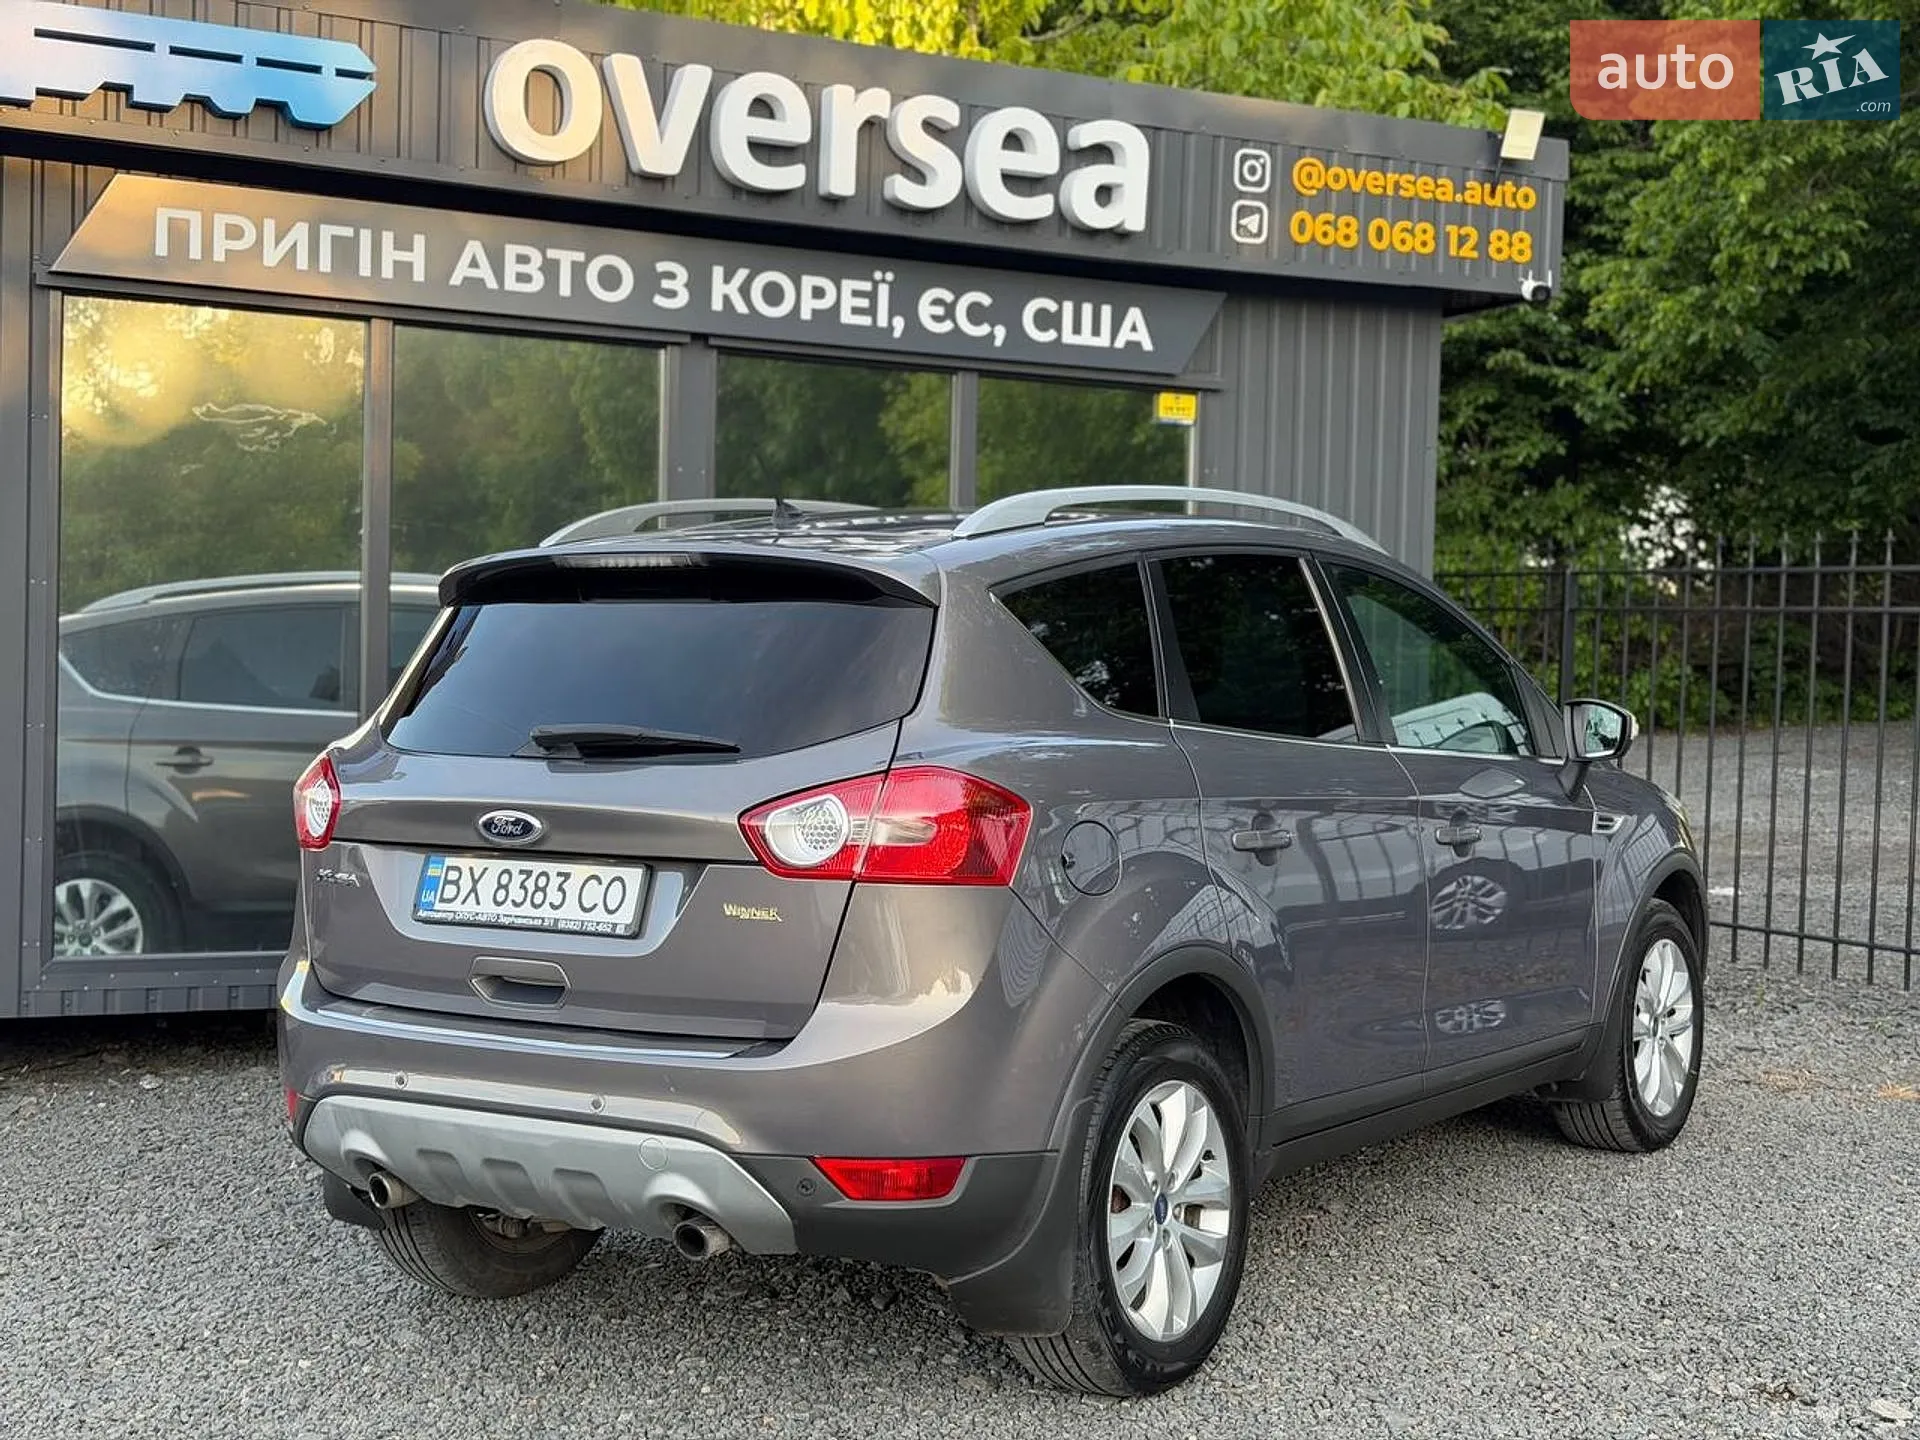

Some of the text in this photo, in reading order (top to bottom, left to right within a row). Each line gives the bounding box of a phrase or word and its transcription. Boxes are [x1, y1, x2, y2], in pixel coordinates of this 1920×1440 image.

[485, 39, 1150, 234] oversea
[1291, 156, 1537, 211] @oversea.auto
[1289, 210, 1533, 264] 068 068 12 88
[154, 206, 1153, 352] ПРИГІН АВТО З КОРЕЇ, ЄС, США
[491, 816, 523, 835] Ford
[421, 890, 435, 903] UA
[438, 865, 627, 915] BX 8383 CO
[723, 903, 782, 921] WINNER
